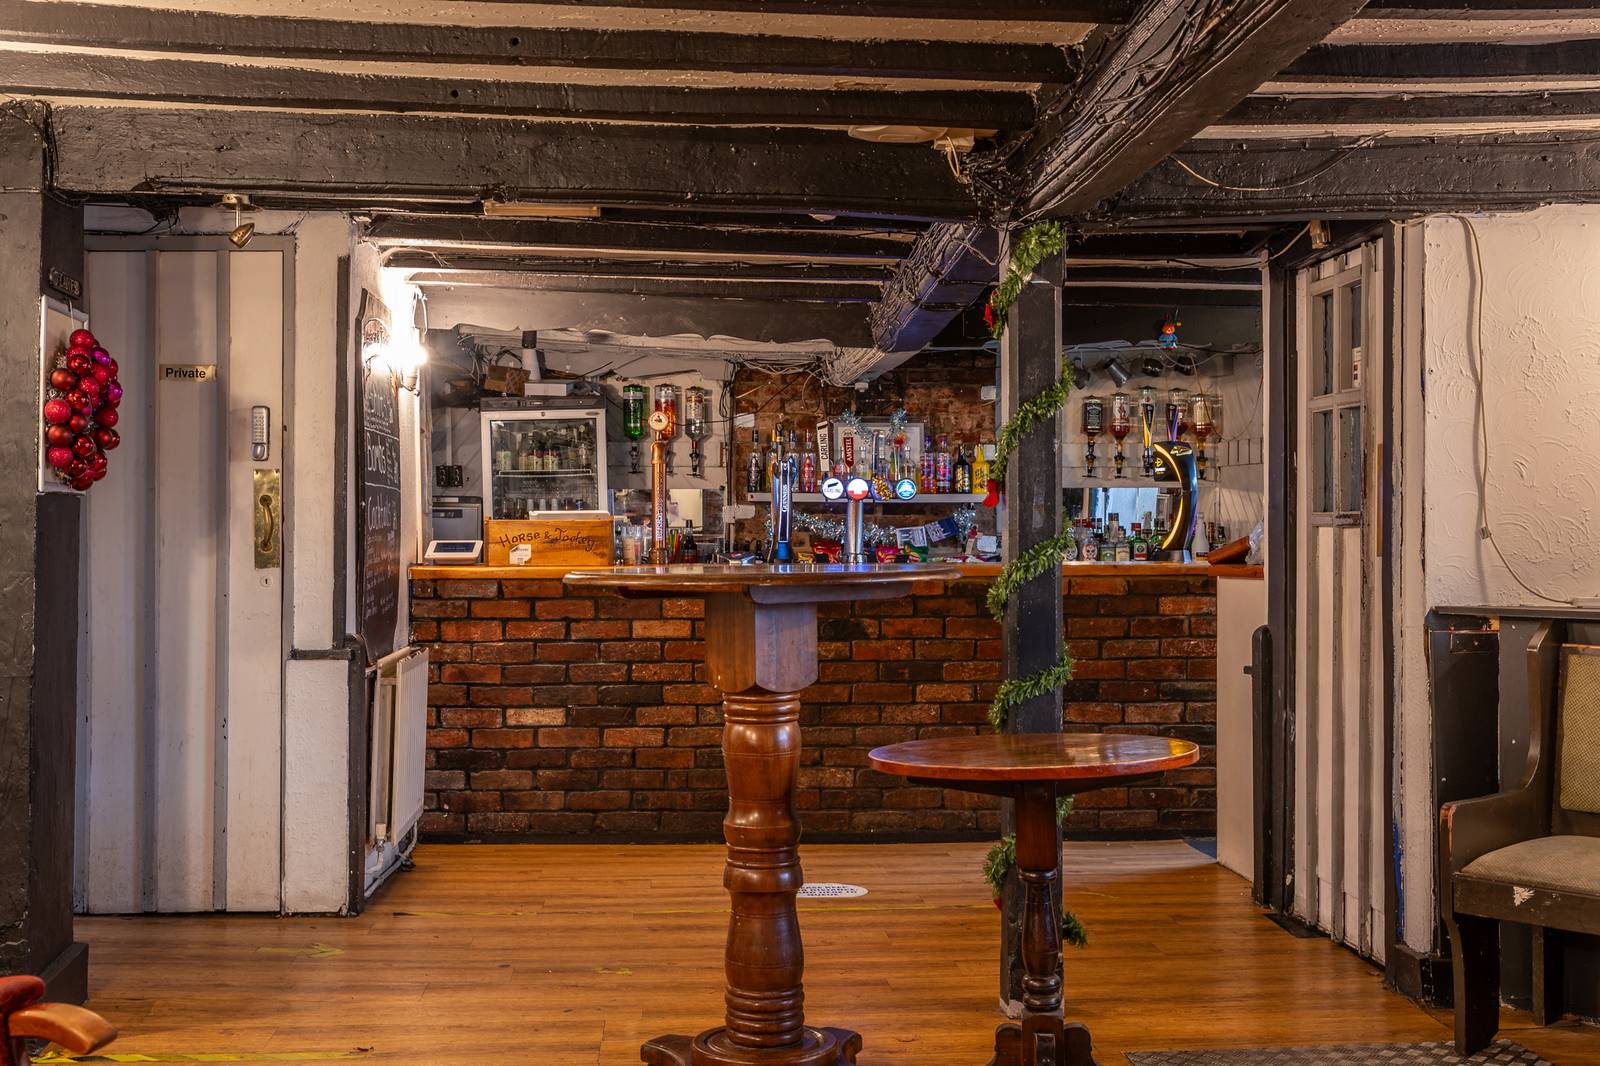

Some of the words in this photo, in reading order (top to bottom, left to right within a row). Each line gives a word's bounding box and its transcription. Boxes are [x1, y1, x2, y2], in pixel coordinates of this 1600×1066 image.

[166, 368, 206, 379] Private
[820, 433, 829, 460] CARLING
[544, 531, 552, 539] &
[554, 528, 594, 552] Jockey
